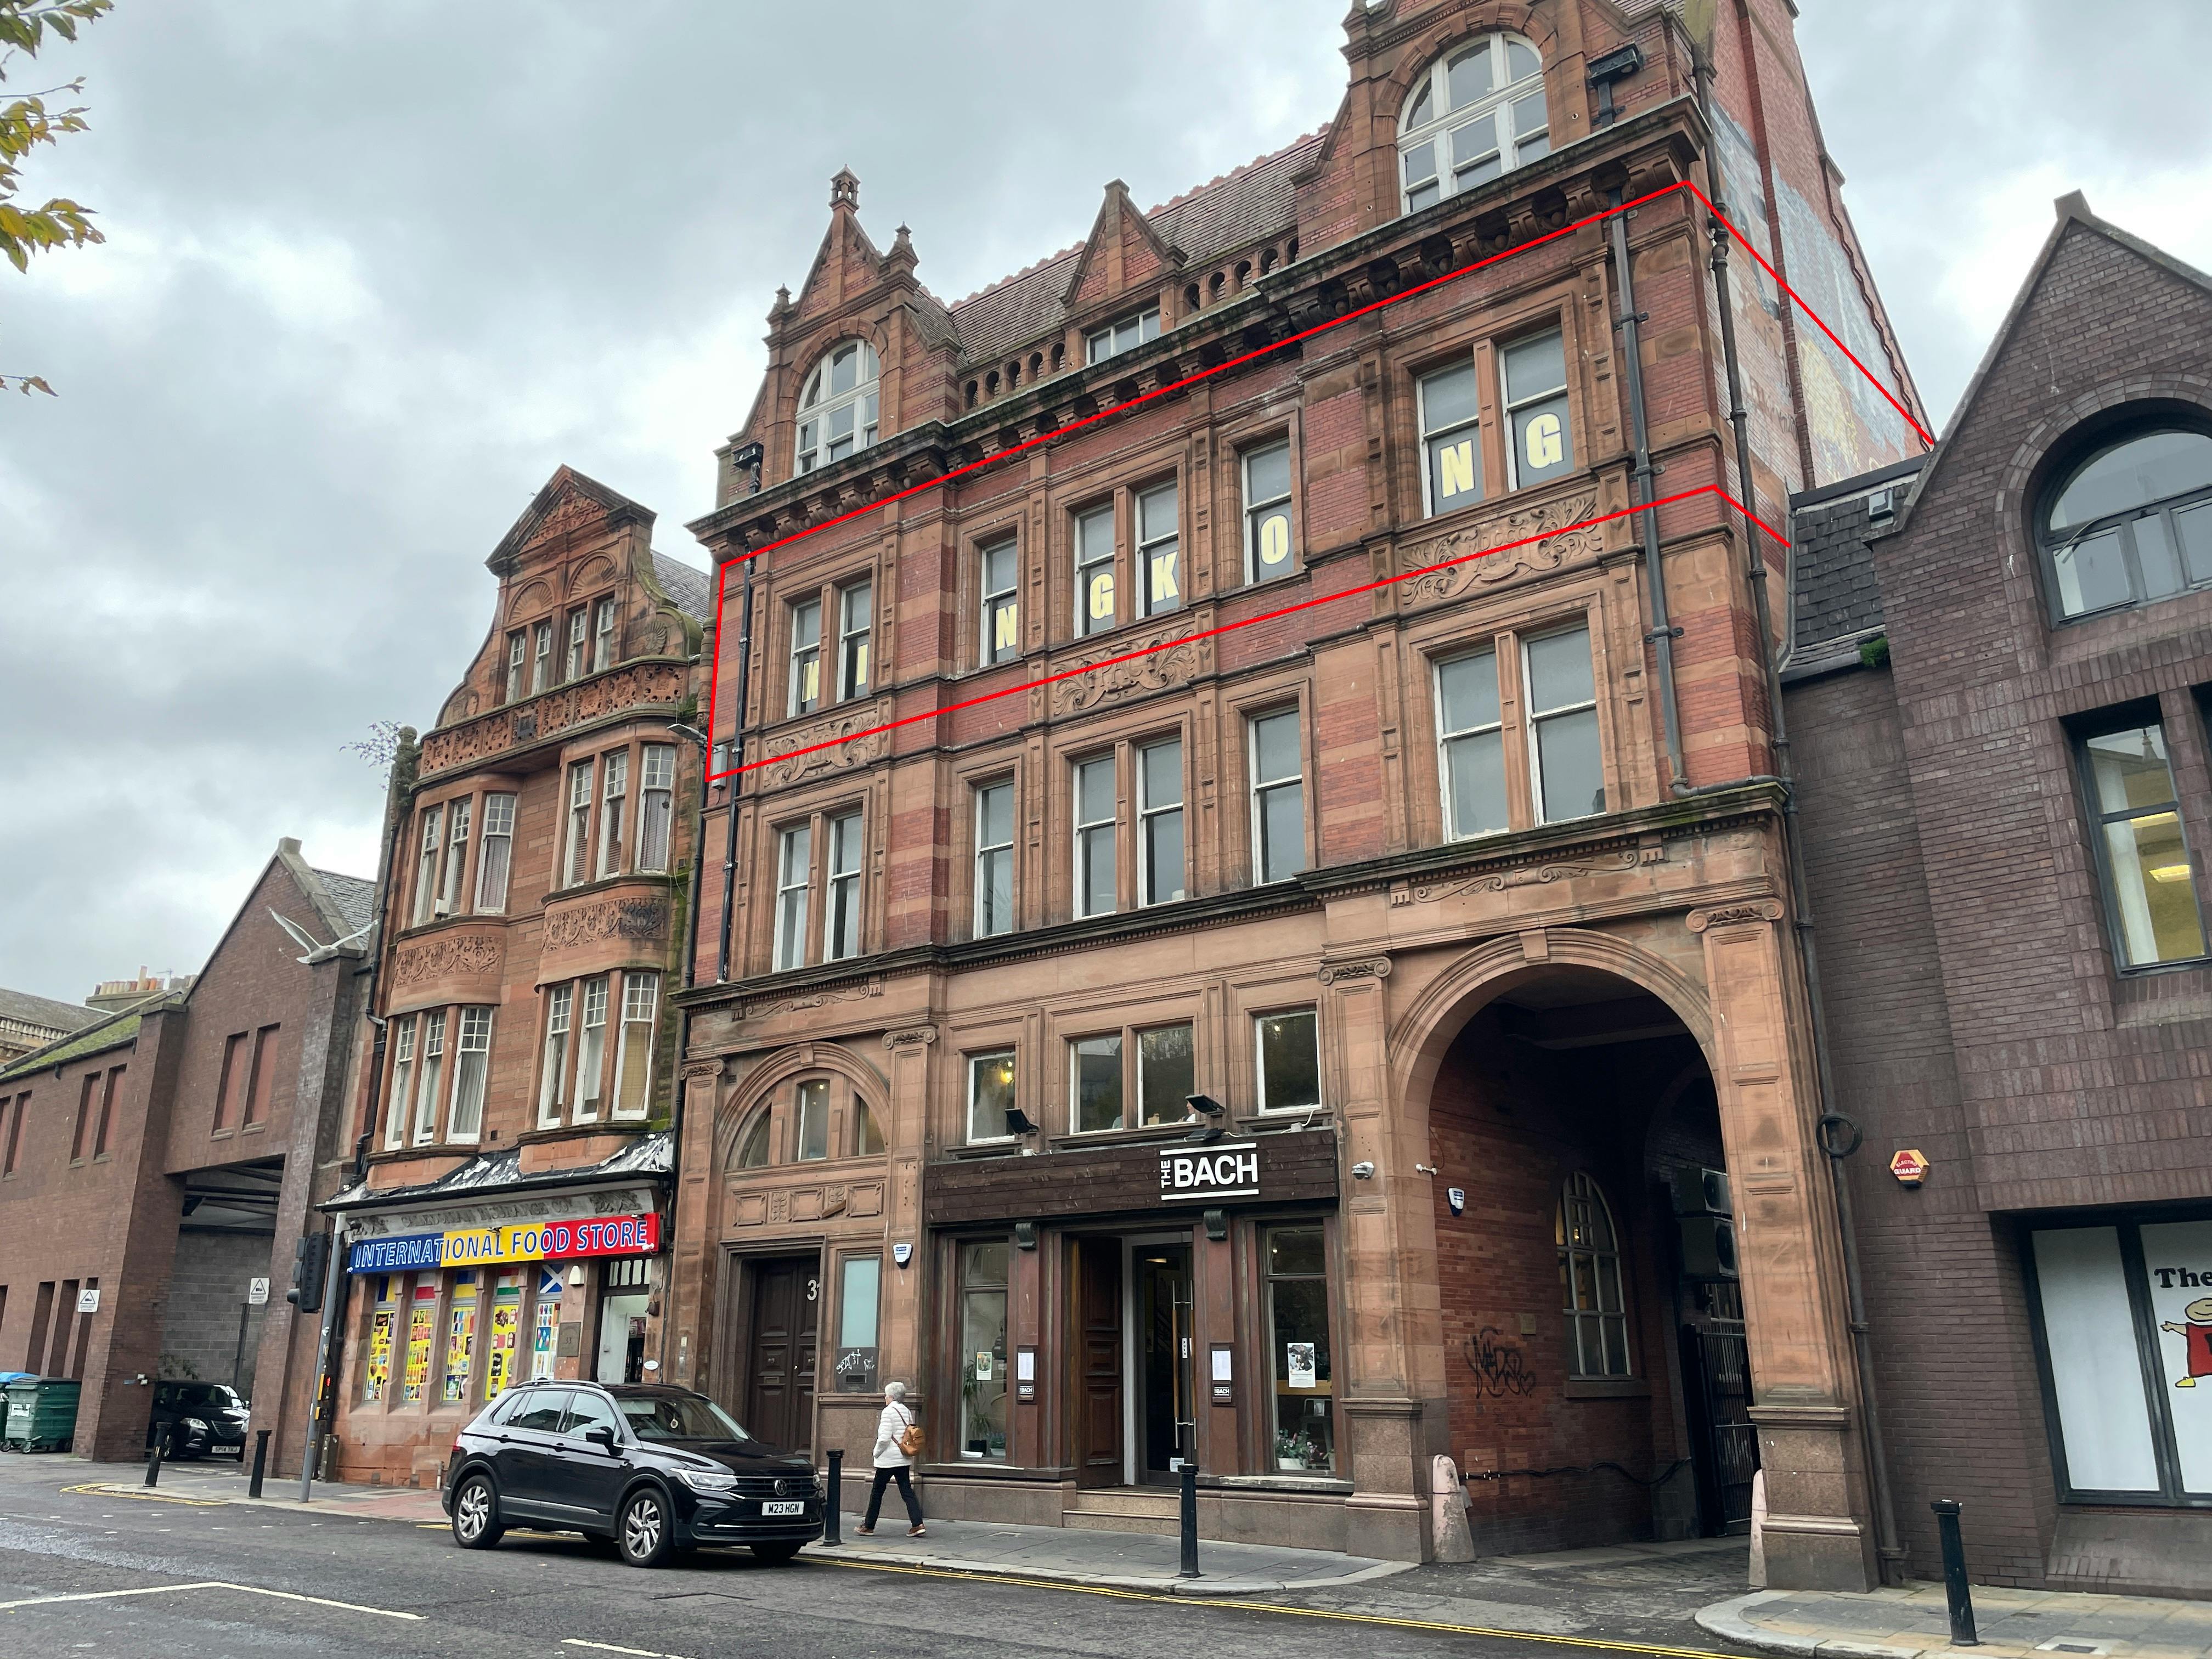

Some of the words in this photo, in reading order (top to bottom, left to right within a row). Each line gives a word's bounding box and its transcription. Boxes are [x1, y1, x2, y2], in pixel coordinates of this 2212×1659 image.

[1160, 1160, 1171, 1188] THE
[1174, 1153, 1258, 1187] BACH
[354, 1234, 504, 1268] INTERNATIONAL
[512, 1227, 570, 1255] FOOD
[577, 1220, 647, 1251] STORE
[2154, 1267, 2212, 1288] The
[807, 1279, 820, 1301] 3
[768, 1504, 784, 1514] M23
[785, 1503, 799, 1513] HGN
